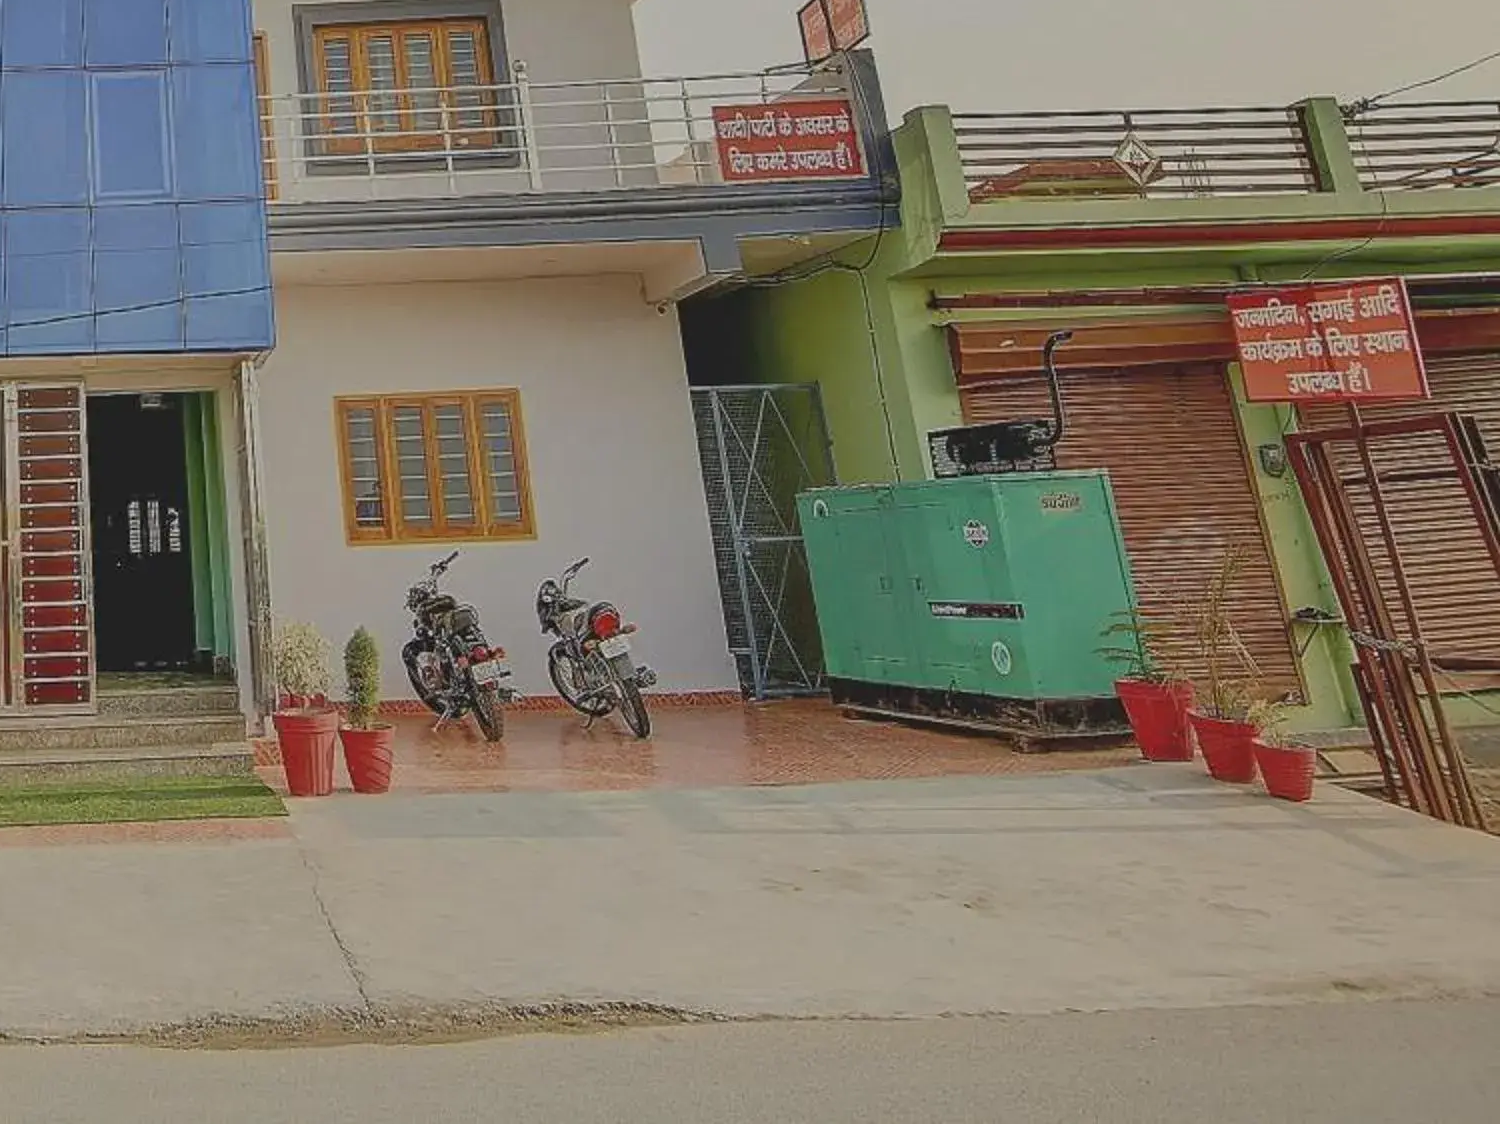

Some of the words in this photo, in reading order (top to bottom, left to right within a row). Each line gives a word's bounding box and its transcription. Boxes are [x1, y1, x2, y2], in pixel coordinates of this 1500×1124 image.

[1306, 289, 1356, 322] सगाई
[1359, 284, 1400, 318] आदि
[1238, 333, 1303, 362] कार्यक्रम
[1304, 330, 1323, 357] के
[1324, 327, 1363, 357] लिए
[1364, 329, 1410, 354] स्थान
[1286, 371, 1344, 394] उपलब्ध
